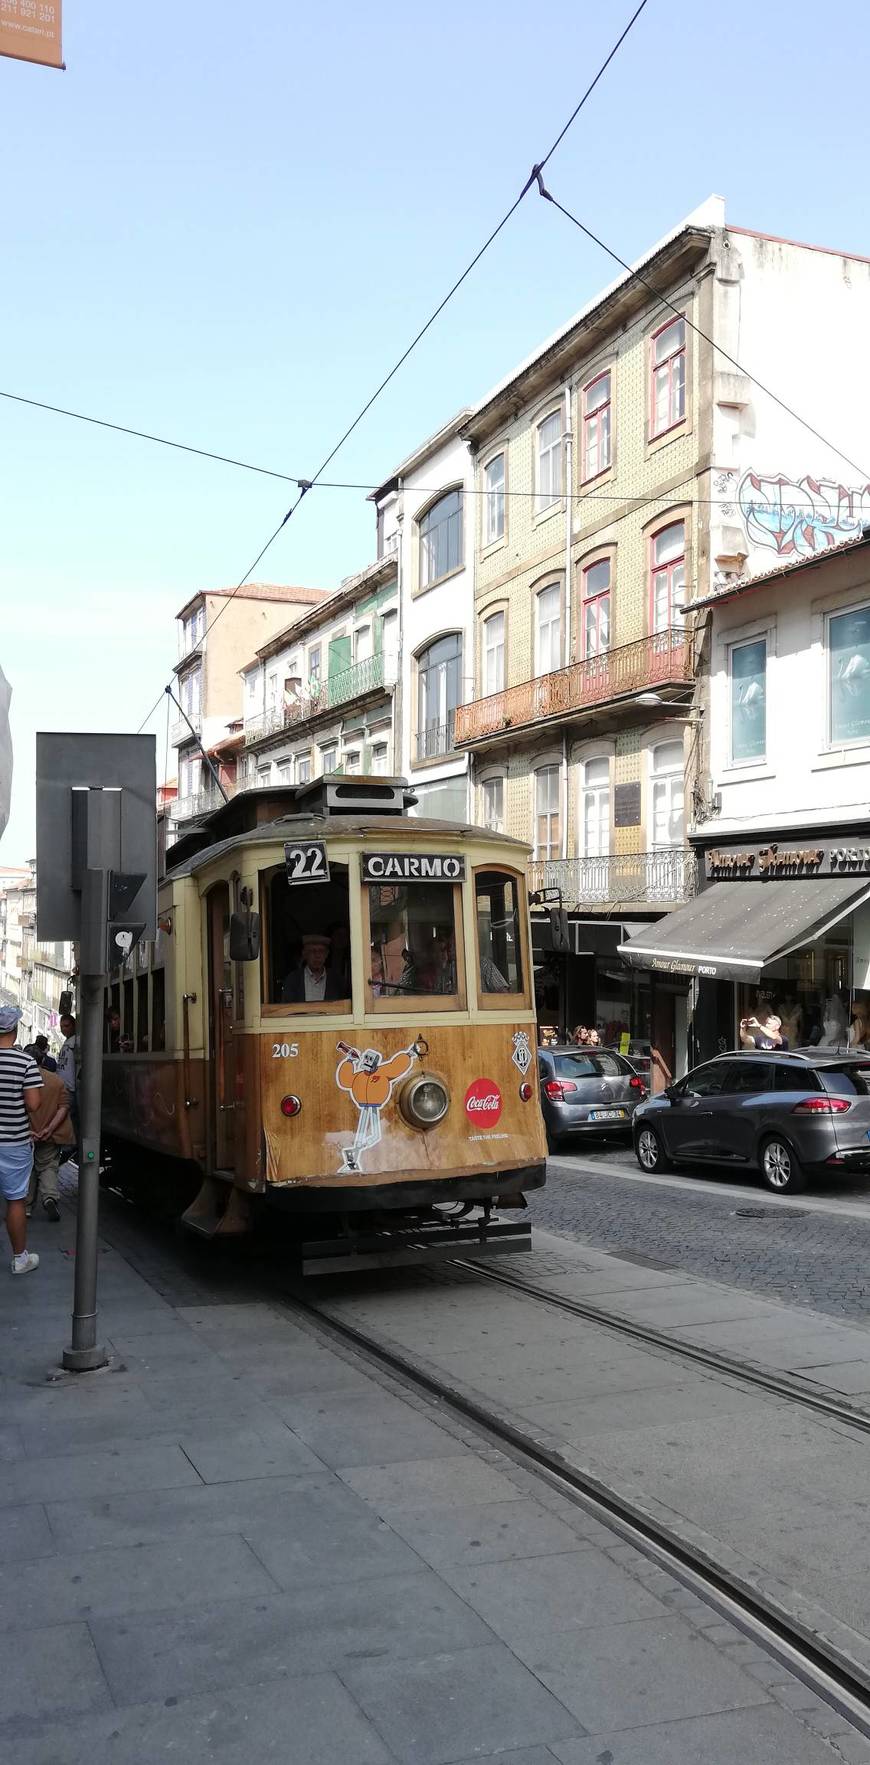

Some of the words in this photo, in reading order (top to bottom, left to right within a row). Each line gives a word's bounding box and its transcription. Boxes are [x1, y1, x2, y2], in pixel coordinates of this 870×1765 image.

[289, 848, 325, 878] 22
[829, 847, 870, 863] PORTO
[367, 857, 461, 877] CARMO
[651, 958, 670, 969] Amour
[670, 959, 696, 972] Glamour
[698, 965, 717, 976] PORTO
[272, 1043, 299, 1058] 205
